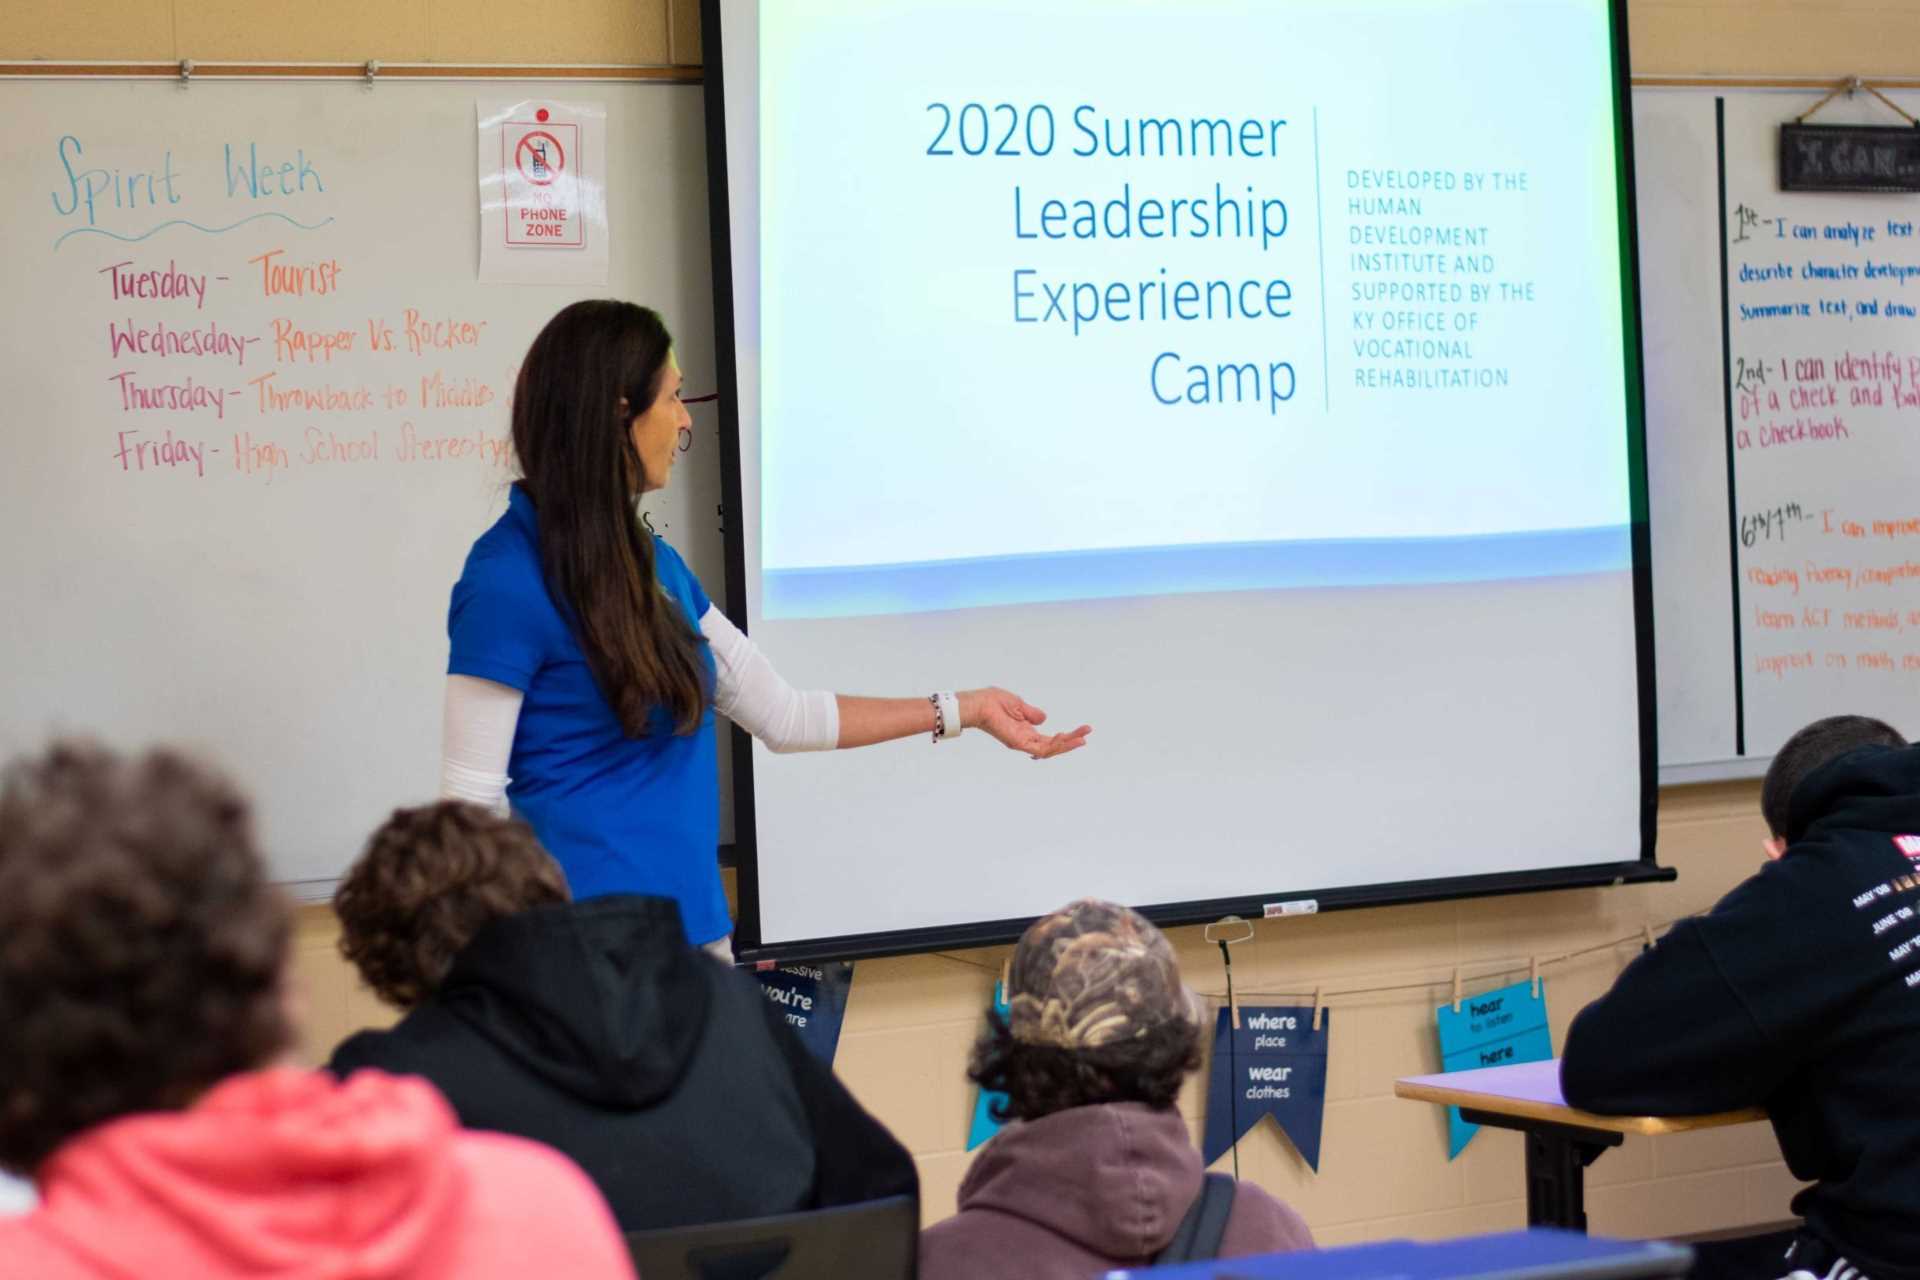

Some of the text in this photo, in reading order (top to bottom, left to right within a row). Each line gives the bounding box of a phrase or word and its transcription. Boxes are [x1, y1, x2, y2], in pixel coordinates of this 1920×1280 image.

[926, 103, 1287, 157] 2020 Summer
[52, 135, 324, 225] Spirit Week
[1347, 169, 1528, 191] DEVELOPED BY THE
[520, 208, 568, 221] PHONE
[1015, 182, 1288, 251] Leadership
[1348, 197, 1422, 216] HUMAN
[526, 224, 563, 237] ZONE
[1349, 225, 1489, 246] DEVELOPMENT
[1776, 217, 1787, 239] I
[1793, 223, 1817, 240] can
[1886, 219, 1913, 237] text
[248, 249, 342, 297] Tourist
[1351, 253, 1494, 274] INSTITUTE AND
[1739, 262, 1793, 283] describe
[1013, 267, 1292, 336] Experience
[1351, 282, 1536, 302] SUPPORTED BY THE
[1856, 299, 1878, 316] and
[1885, 302, 1916, 317] draw
[1353, 311, 1478, 331] KY OFFICE OF
[271, 316, 357, 362] Rapper
[404, 308, 488, 357] Rocker
[1353, 339, 1473, 360] VOCATIONAL
[1355, 368, 1509, 389] REHABILITATION
[1795, 357, 1825, 382] can
[1835, 350, 1902, 388] identify
[248, 370, 373, 415] Throwback
[383, 384, 408, 411] to
[1151, 351, 1296, 416] Camp
[1740, 383, 1760, 420] of
[1768, 390, 1781, 412] a
[1790, 383, 1838, 411] check
[1850, 383, 1884, 408] and
[299, 425, 379, 466] School
[1736, 429, 1751, 450] a
[1470, 997, 1505, 1018] hear
[1248, 1013, 1297, 1031] where
[1254, 1034, 1287, 1051] place
[1479, 1045, 1515, 1066] here
[1248, 1066, 1293, 1082] wear
[1245, 1085, 1290, 1100] clothes
